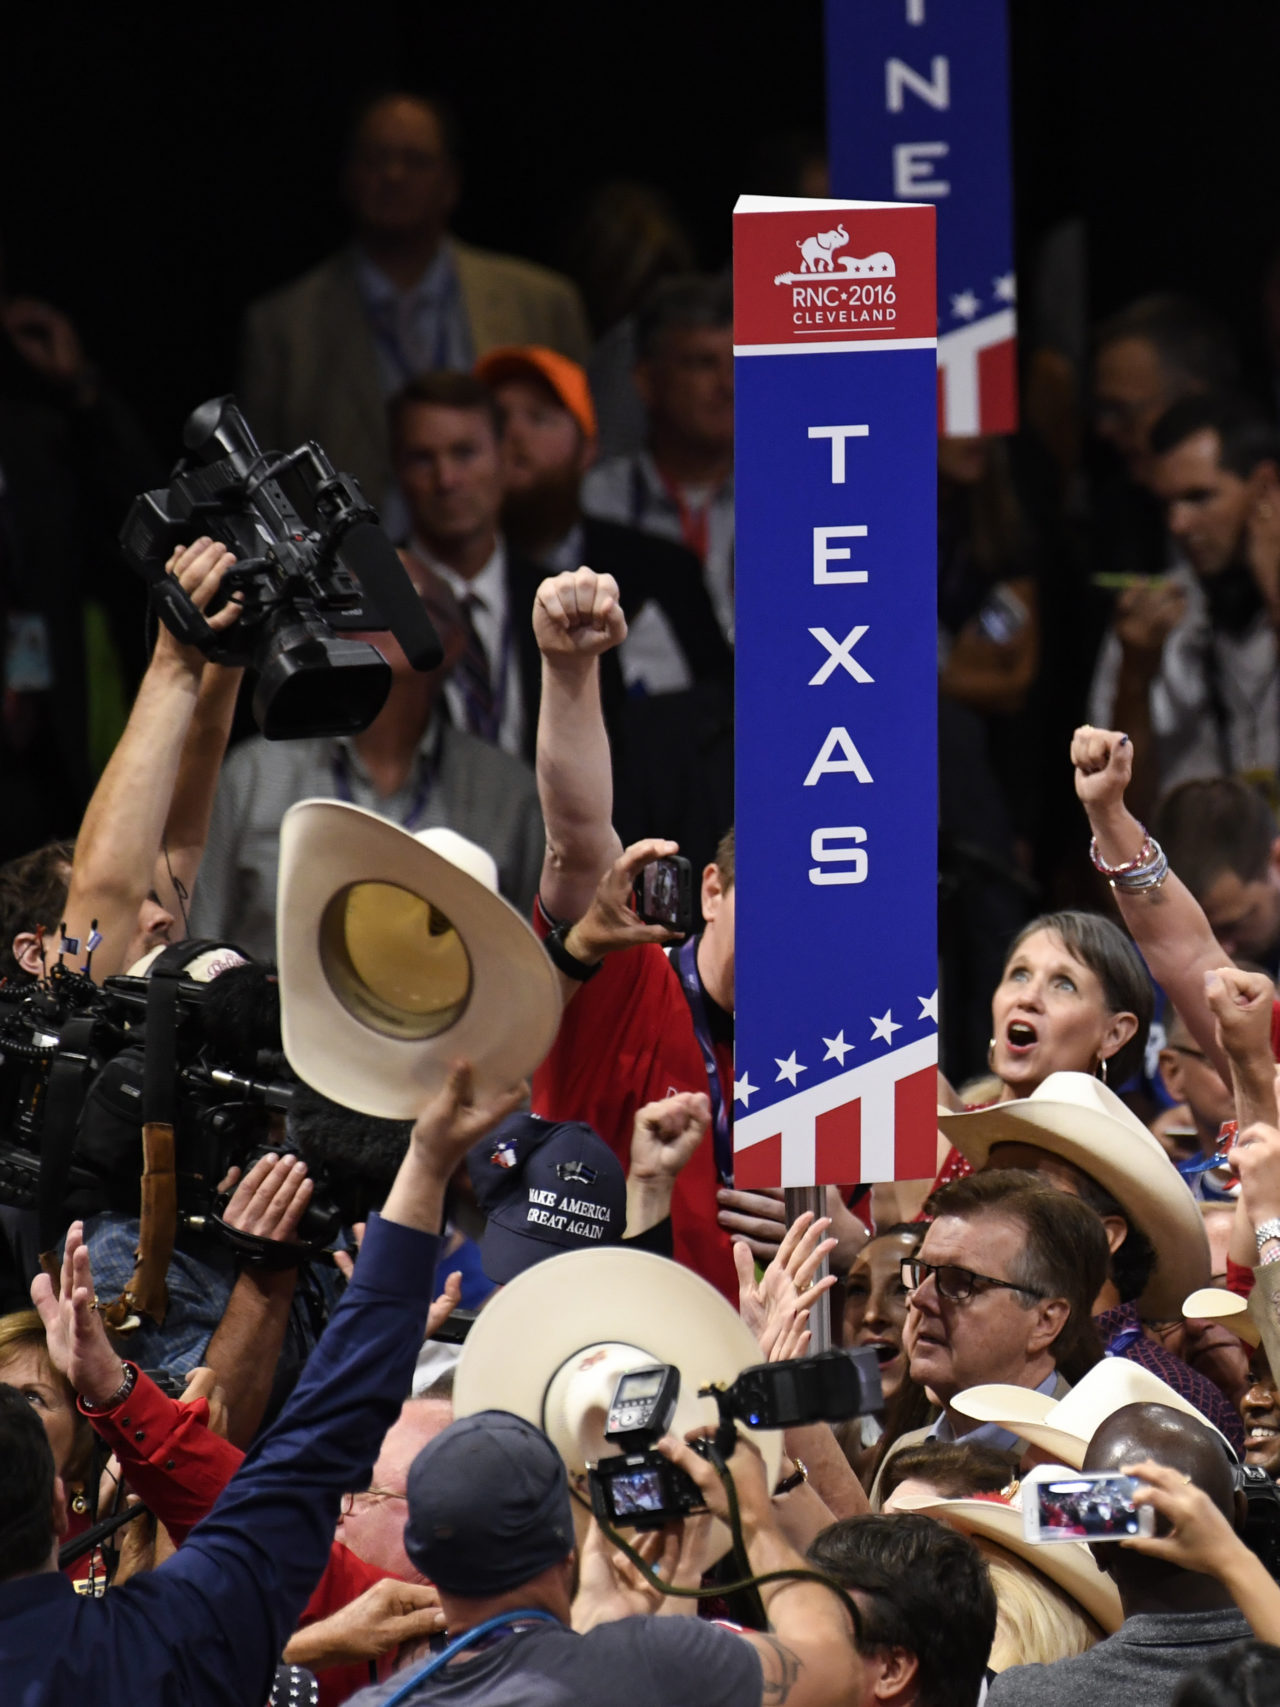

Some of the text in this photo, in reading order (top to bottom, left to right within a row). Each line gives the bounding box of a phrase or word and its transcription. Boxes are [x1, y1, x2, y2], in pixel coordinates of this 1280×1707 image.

[848, 284, 897, 306] 2016
[792, 308, 897, 325] CLEVELAND
[803, 424, 875, 887] TEXAS
[529, 1188, 610, 1221] MAKE AMERICA
[528, 1208, 603, 1238] GREAT AGAIN
